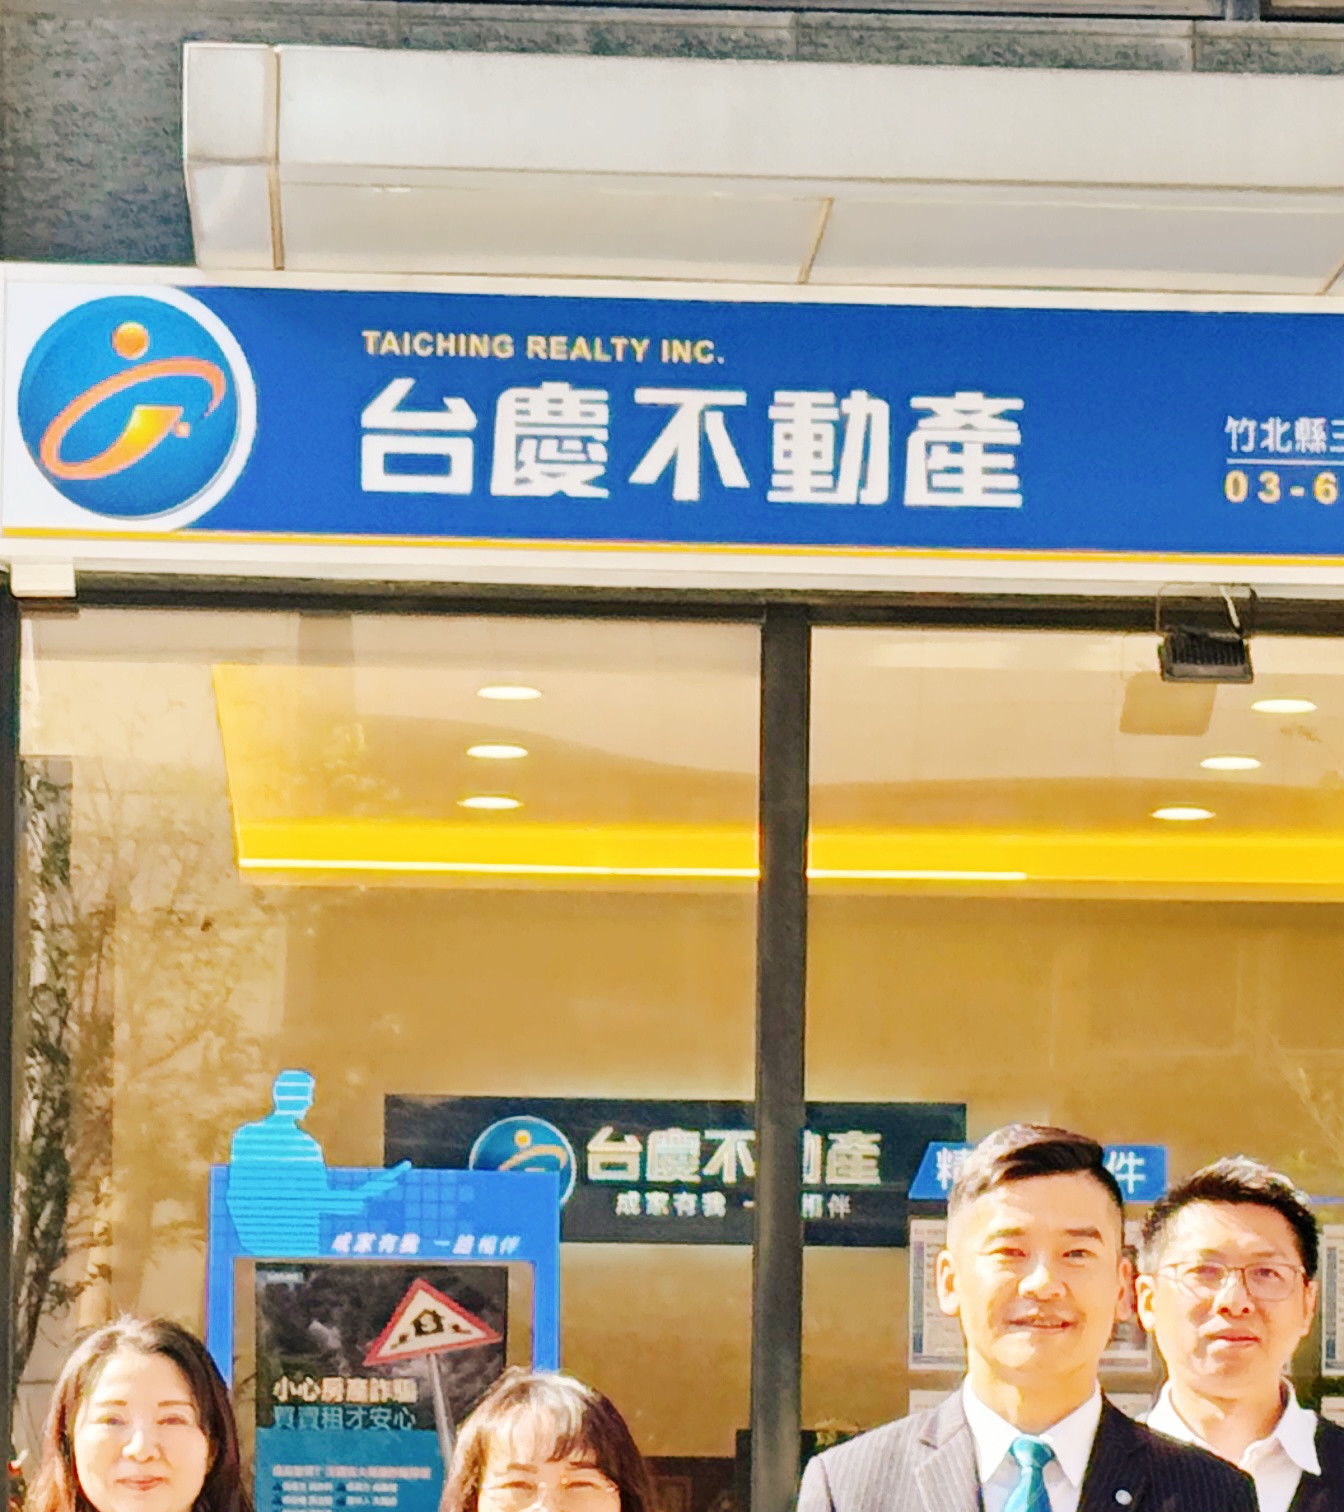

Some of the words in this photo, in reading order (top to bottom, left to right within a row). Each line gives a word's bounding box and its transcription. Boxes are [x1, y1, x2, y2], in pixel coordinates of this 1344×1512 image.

[362, 330, 514, 360] TAICHING
[526, 334, 650, 363] REALTY
[661, 337, 725, 365] INC.
[359, 377, 1025, 508] 台慶不動產
